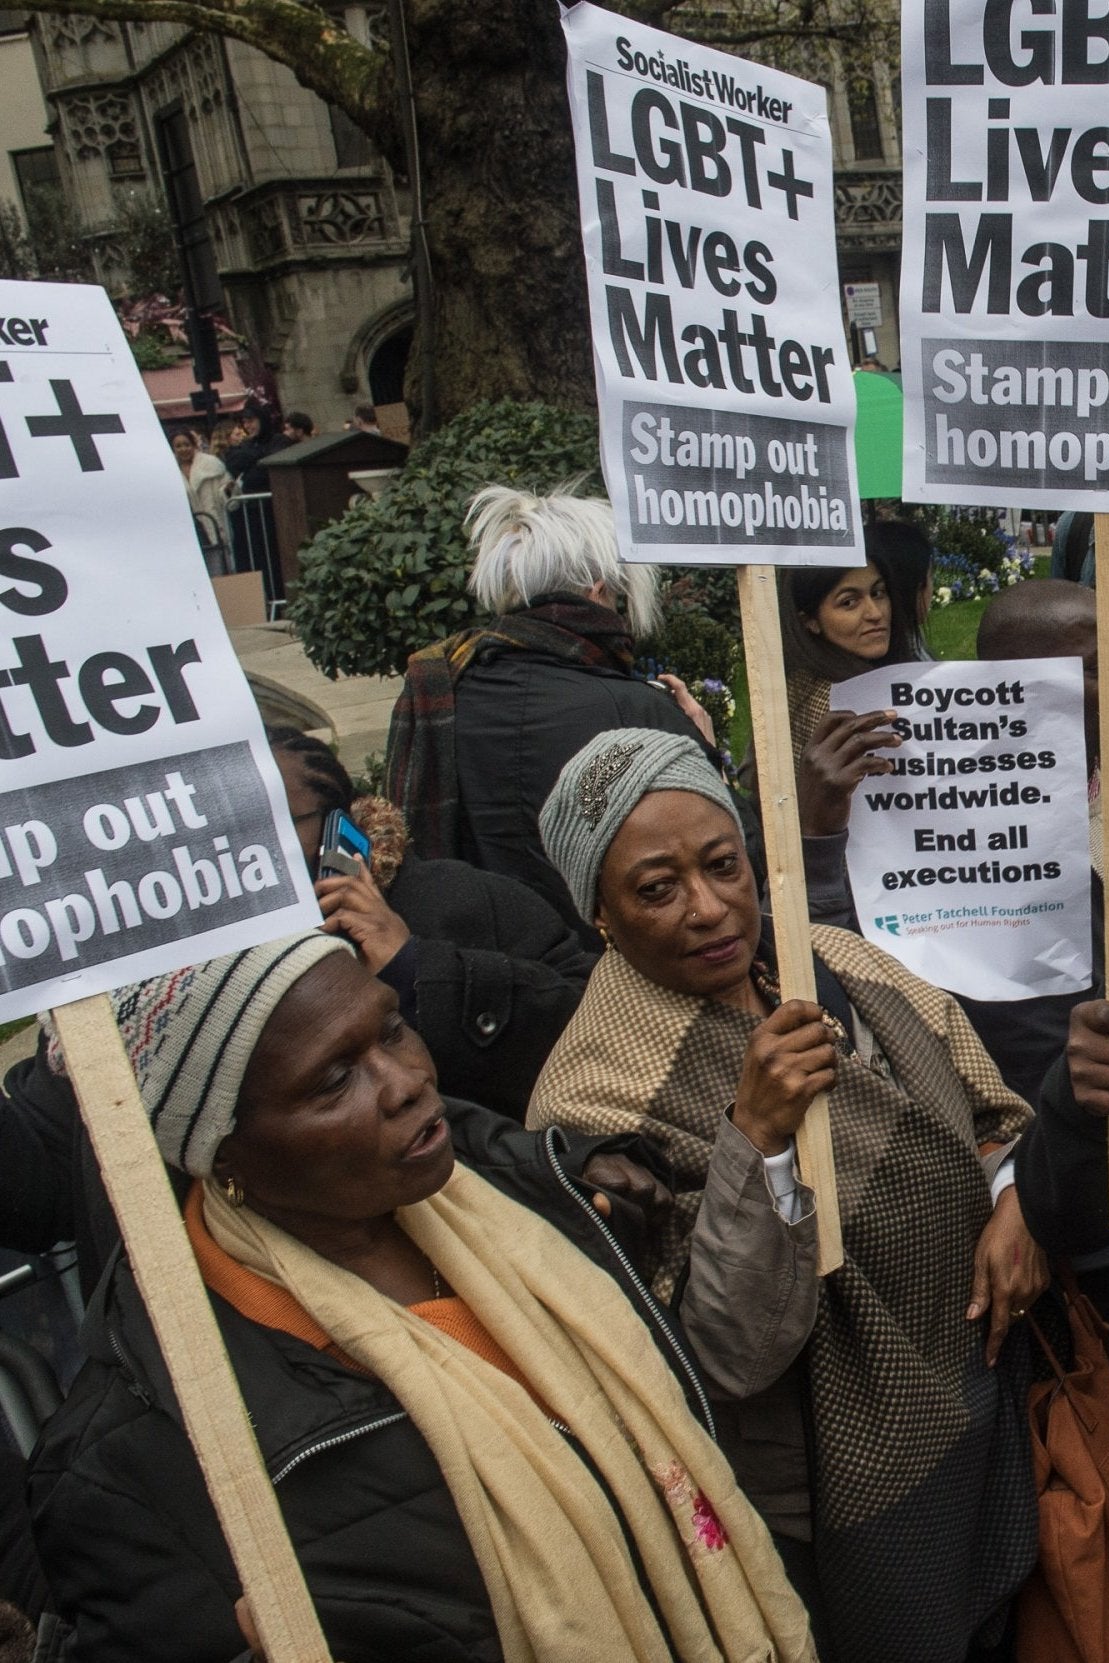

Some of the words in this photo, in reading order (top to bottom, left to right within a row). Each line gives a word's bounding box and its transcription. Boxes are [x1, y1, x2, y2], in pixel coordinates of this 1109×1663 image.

[586, 70, 814, 220] LGBT+
[596, 177, 778, 305] Lives
[605, 284, 835, 403] Matter
[932, 349, 1109, 417] Stamp
[630, 412, 757, 480] Stamp
[768, 433, 819, 477] out
[635, 474, 847, 536] homophobia
[890, 680, 1025, 713] Boycott
[83, 771, 208, 851] out
[864, 781, 1051, 812] worldwide.
[914, 828, 976, 852] End
[987, 825, 1028, 850] all
[0, 835, 280, 964] ophobia
[881, 860, 1061, 891] executions
[902, 912, 932, 924] Peter
[935, 906, 987, 922] Tatchell
[991, 901, 1064, 917] Foundation
[940, 922, 954, 931] out
[956, 920, 969, 929] for
[971, 918, 1001, 928] Human
[1003, 918, 1031, 928] Rights
